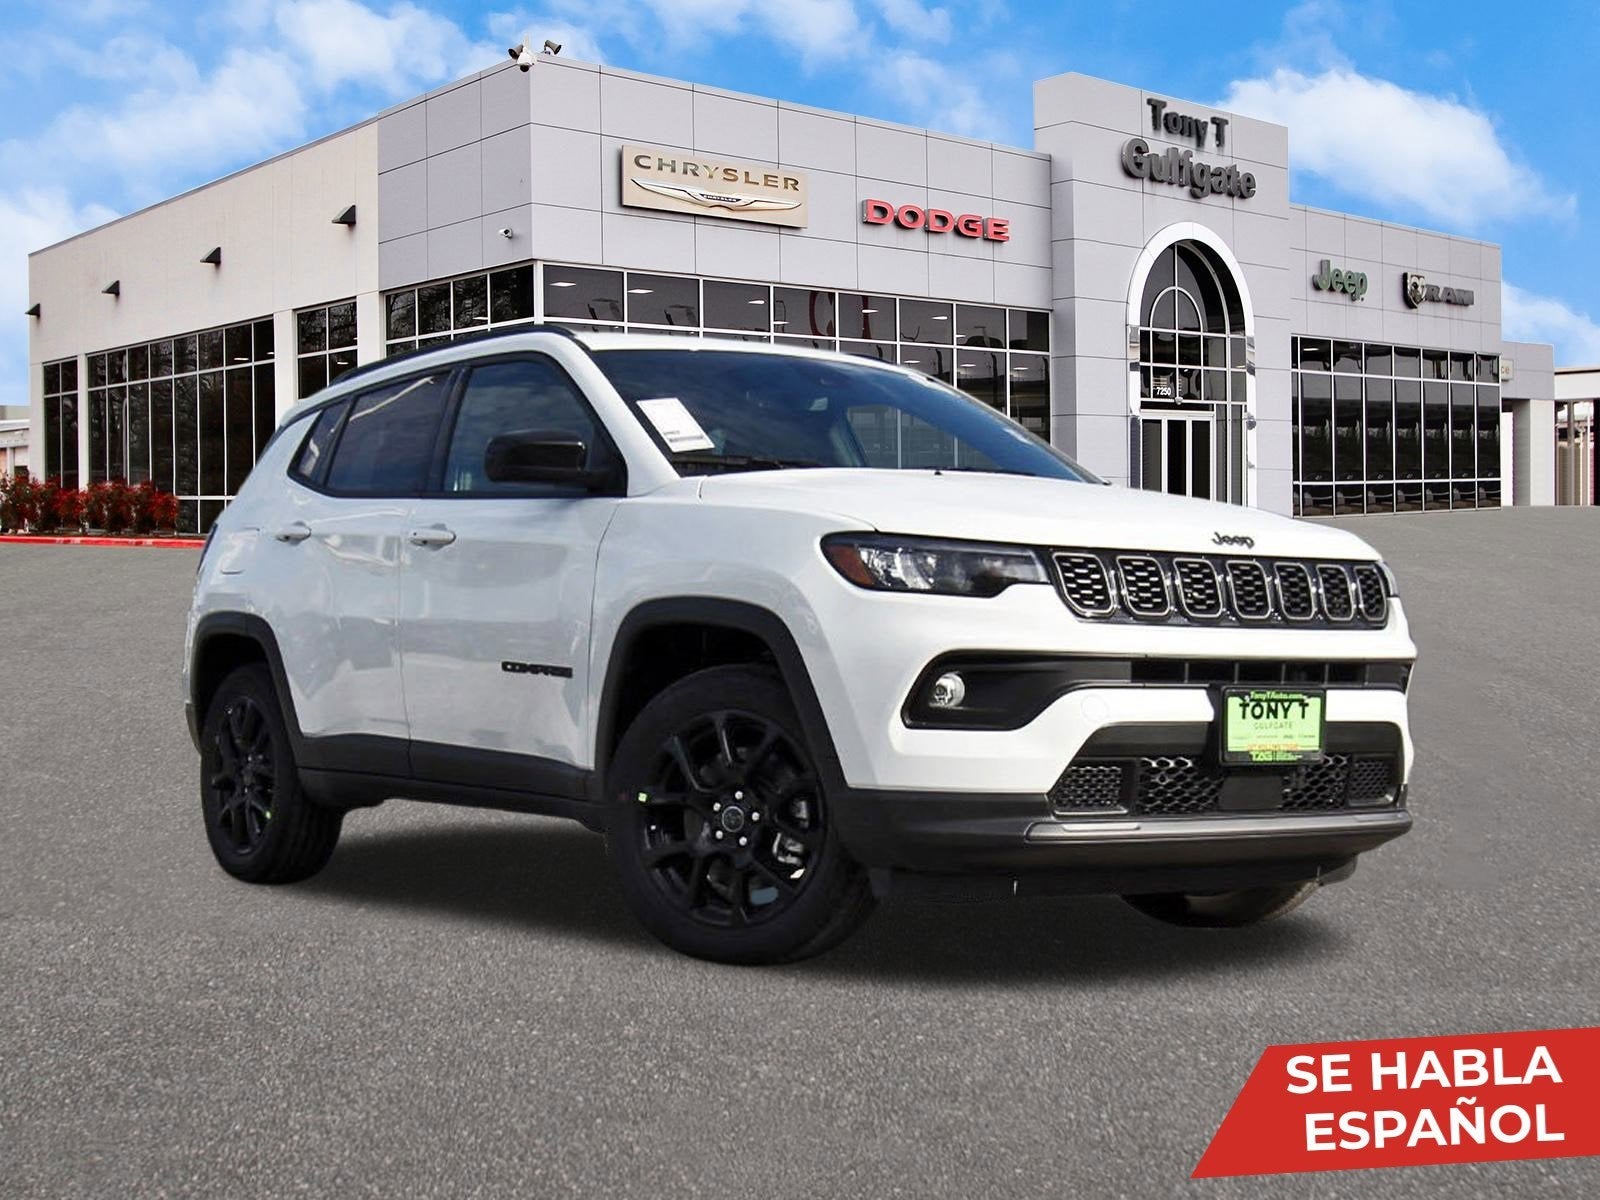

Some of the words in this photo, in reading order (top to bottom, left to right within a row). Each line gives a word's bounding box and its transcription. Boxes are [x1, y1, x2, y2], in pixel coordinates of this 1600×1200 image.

[1146, 98, 1209, 148] Tony
[1210, 116, 1229, 147] T
[633, 154, 800, 191] CHRYSLER
[1121, 138, 1257, 199] Gulfgate
[862, 199, 1010, 242] DODGE
[1312, 259, 1368, 302] Jeep
[1425, 284, 1475, 306] RAM
[1156, 387, 1172, 396] 7250
[1211, 531, 1255, 549] Jeep
[1238, 701, 1293, 720] TONY
[1298, 702, 1309, 720] T
